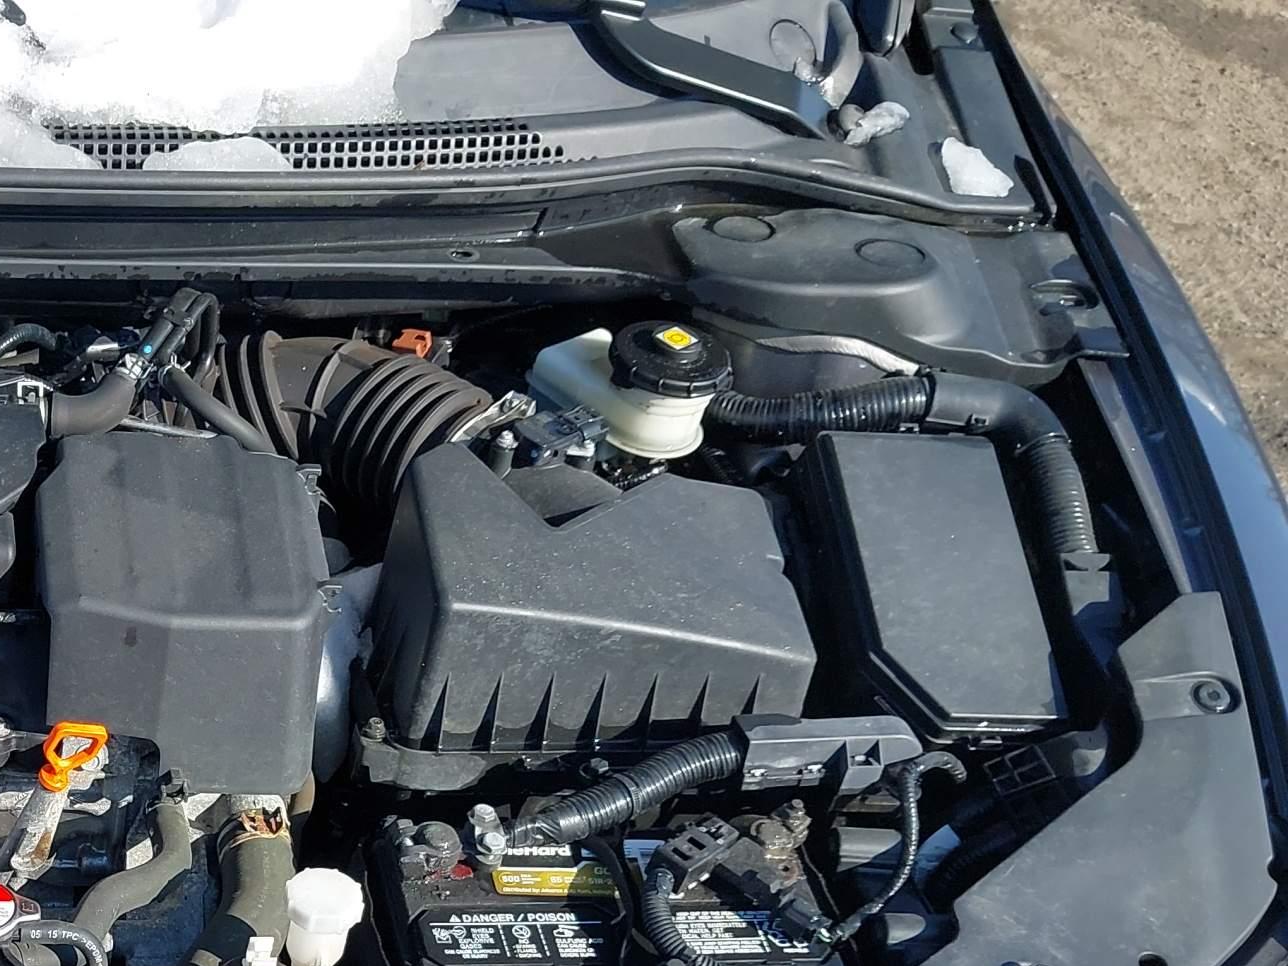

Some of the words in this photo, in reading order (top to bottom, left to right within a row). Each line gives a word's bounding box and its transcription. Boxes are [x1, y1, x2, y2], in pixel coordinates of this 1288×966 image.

[462, 913, 514, 923] DANGER
[516, 913, 525, 922] /
[527, 913, 576, 922] POISON
[30, 929, 41, 939] 05
[47, 929, 58, 939] 15
[62, 930, 80, 941] TPC
